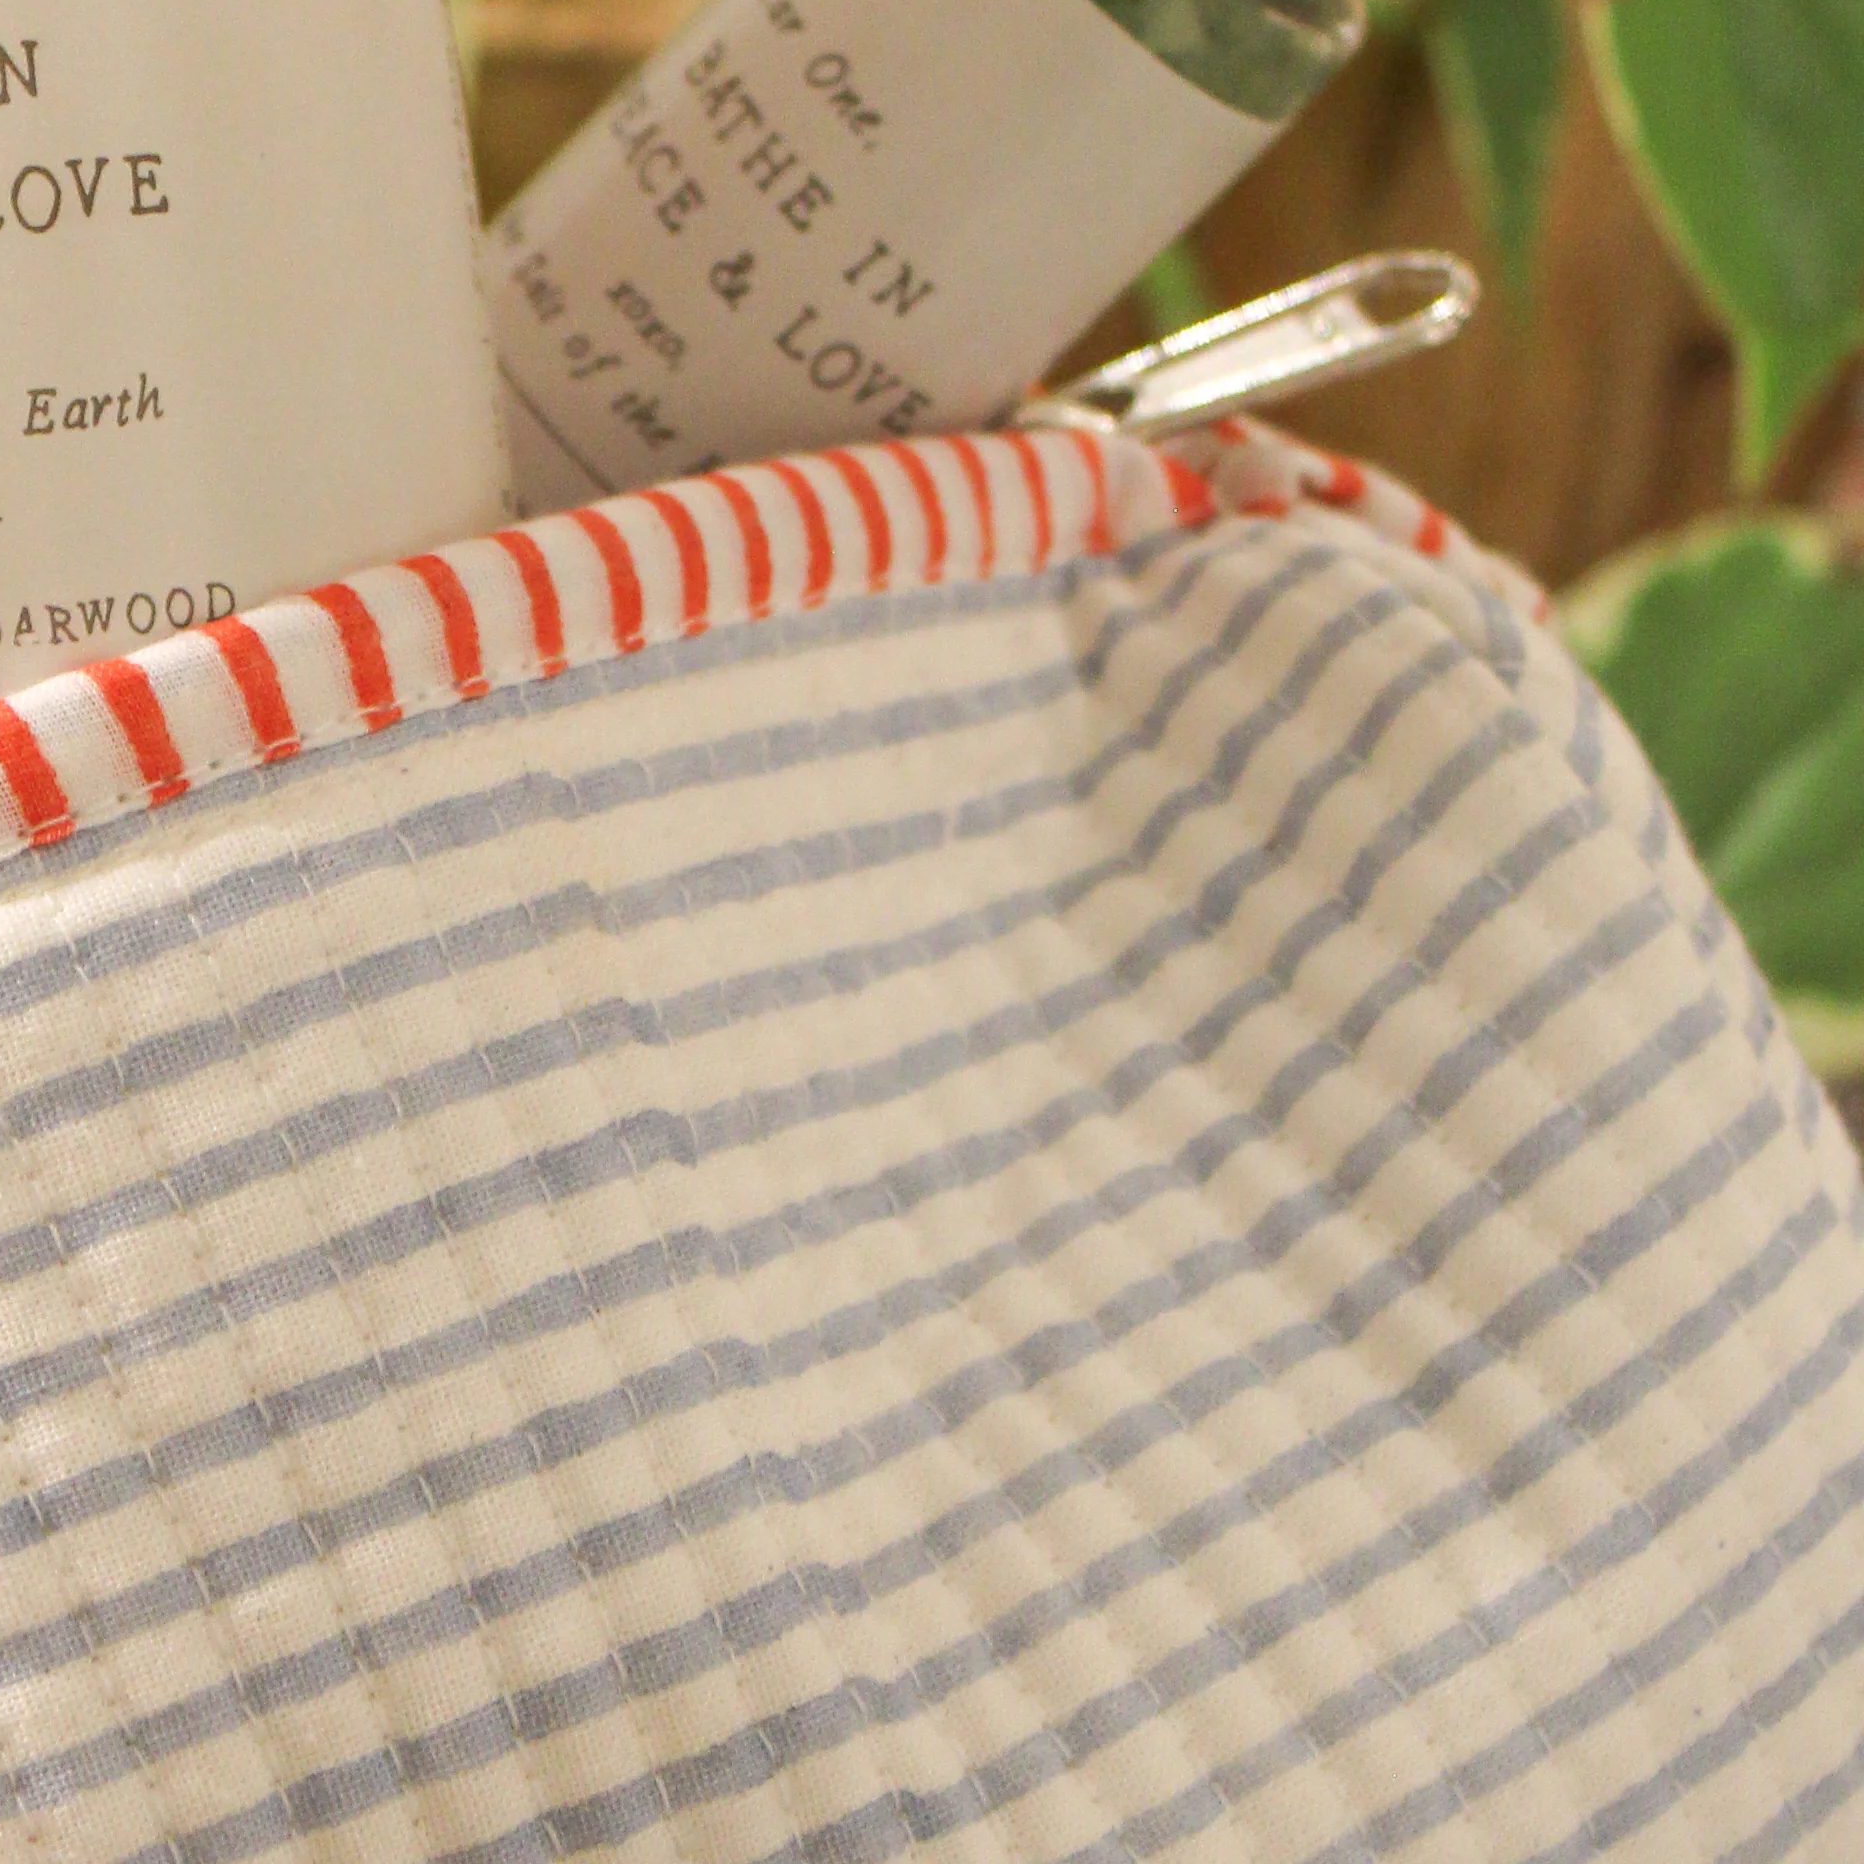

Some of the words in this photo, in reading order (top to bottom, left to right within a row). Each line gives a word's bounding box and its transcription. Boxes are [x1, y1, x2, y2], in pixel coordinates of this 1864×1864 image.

[685, 39, 834, 233] BATHE
[842, 239, 934, 317] IN
[22, 373, 165, 438] Earth
[708, 249, 756, 313] &
[773, 302, 932, 436] LOVE
